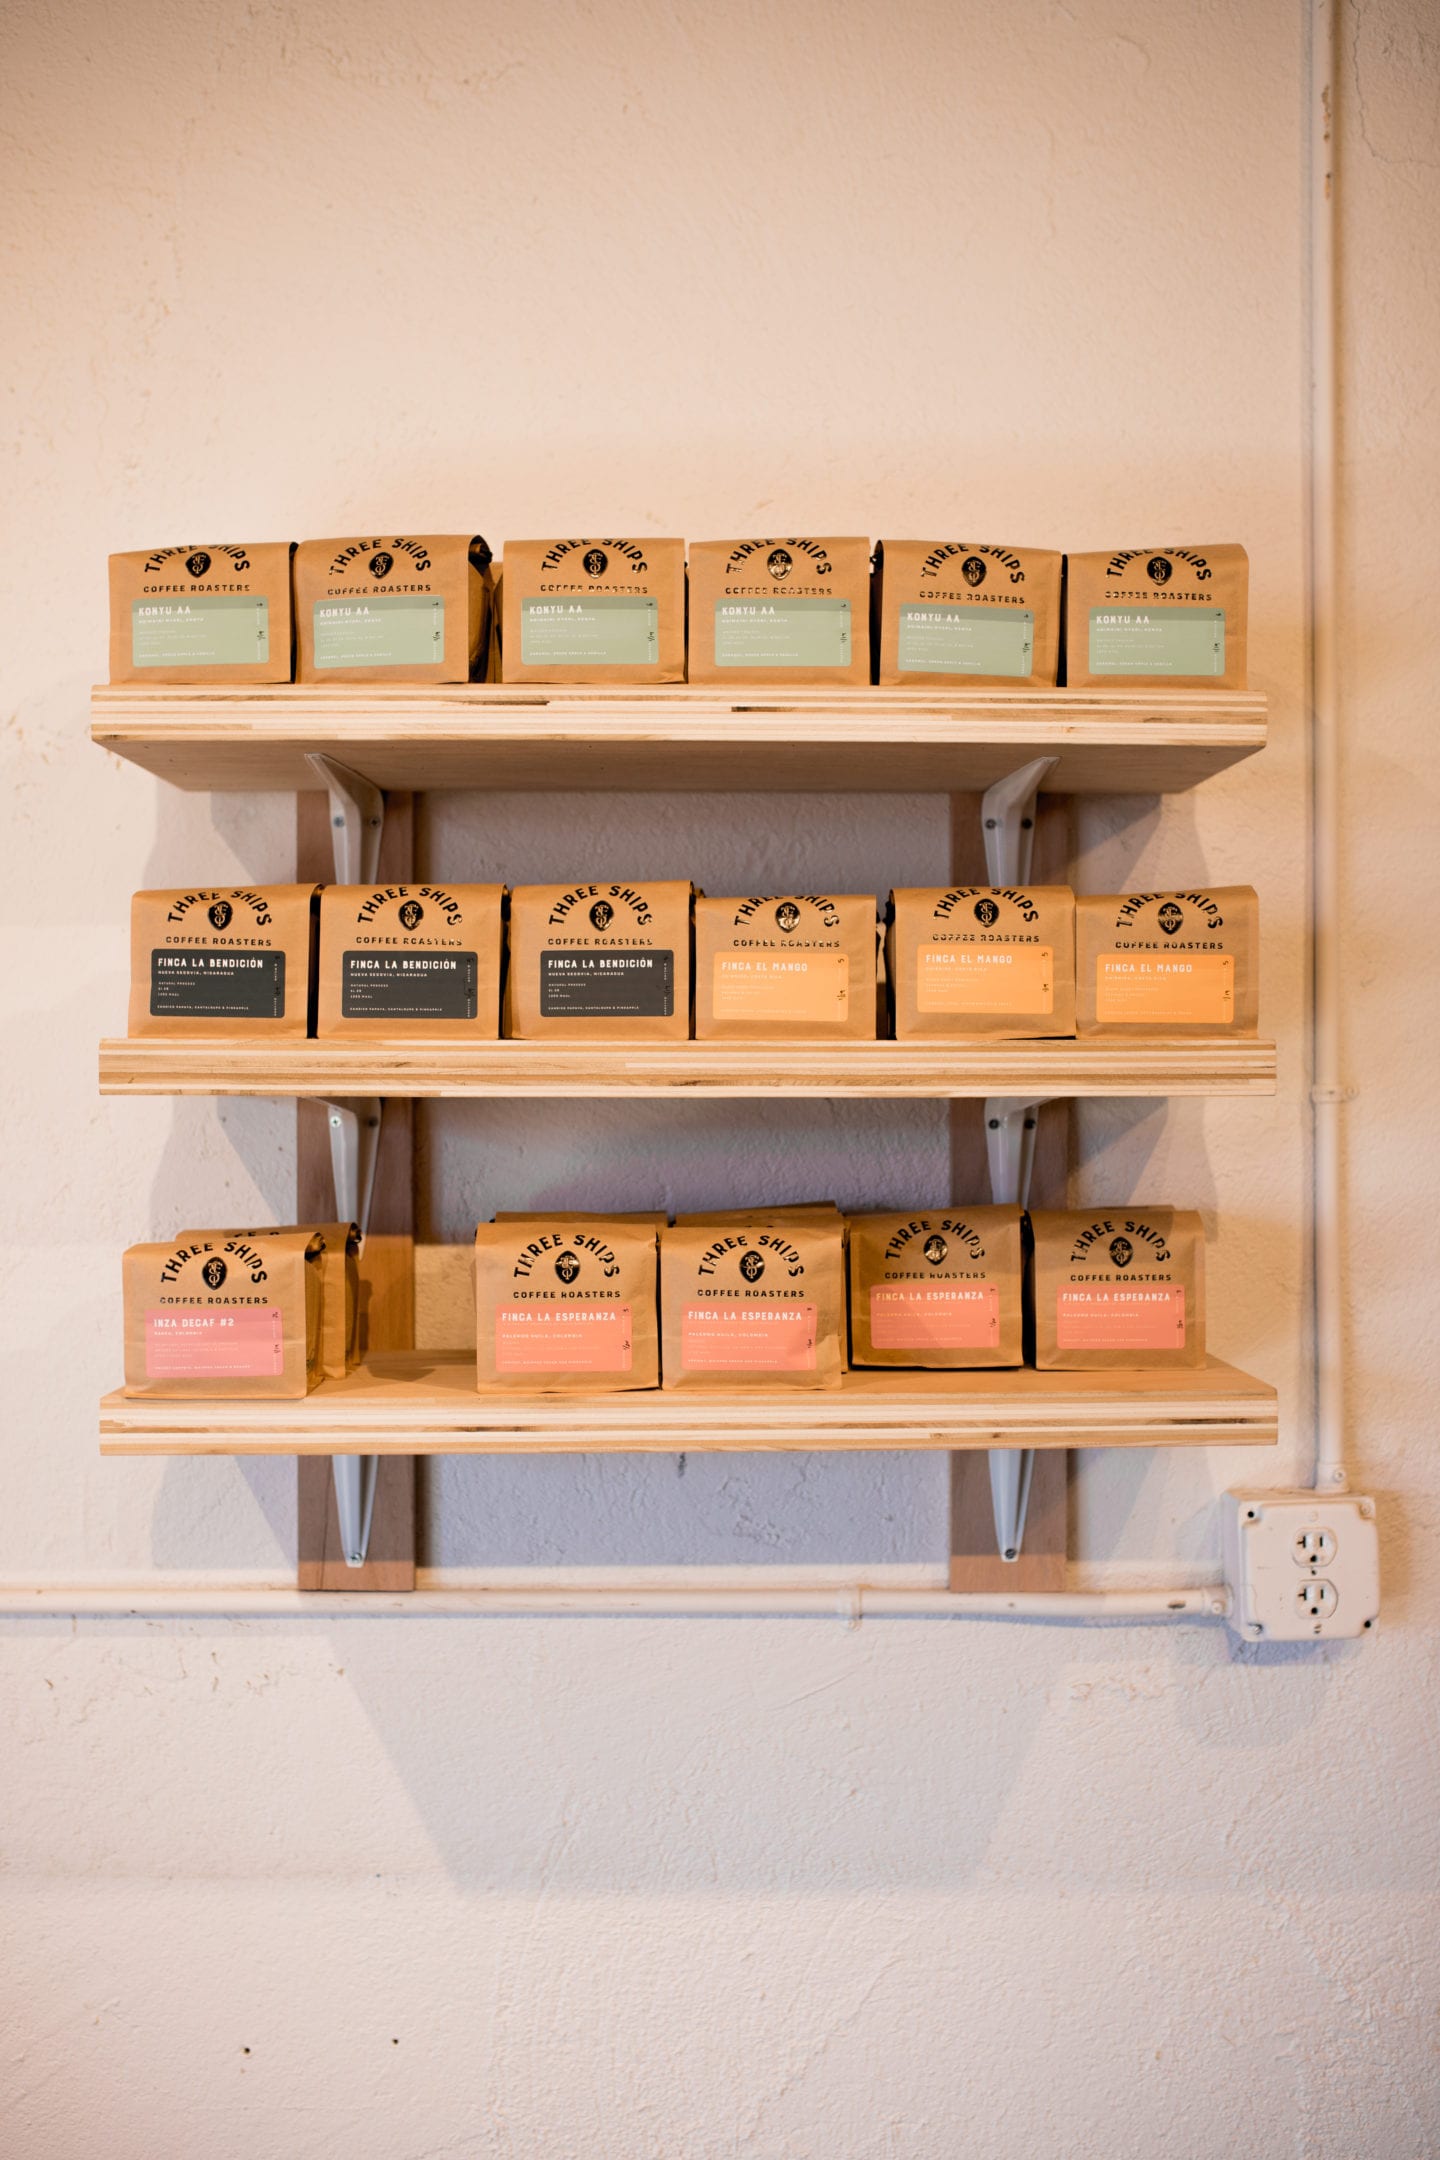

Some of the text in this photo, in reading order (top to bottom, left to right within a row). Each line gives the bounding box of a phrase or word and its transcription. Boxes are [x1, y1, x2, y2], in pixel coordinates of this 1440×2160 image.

[329, 538, 431, 575] THREE SHIPS
[541, 539, 647, 573] THREE SHIPS
[726, 538, 832, 575] THREE SHIPS
[921, 544, 1025, 584] THREE SHIPS
[1164, 548, 1212, 580] SHIPS
[191, 584, 250, 592] ROASTERS
[328, 585, 431, 595] COFFEE ROASTERS
[920, 591, 1025, 604] COFFEE ROASTERS
[139, 607, 172, 616] KONYU
[320, 607, 369, 617] KONYU AA
[530, 606, 563, 614] KONYU
[722, 607, 775, 615] KONYU AA
[907, 613, 960, 623] KONYU AA
[1096, 616, 1150, 624] KONYU AA
[168, 891, 272, 926] THREE SHIPS
[358, 887, 463, 925] THREE SHIPS
[549, 885, 653, 925] THREE SHIPS
[934, 888, 1039, 922] THREE SHIPS
[1116, 893, 1223, 929] THREE SHIPS
[213, 938, 272, 946] ROASTERS
[158, 957, 263, 968] FINCA LA BENDICIÓN
[350, 959, 456, 970] FINCA LA BENDICIÓN
[548, 958, 653, 968] FINCA LA BENDICIÓN
[926, 955, 1012, 964] FINCA EL MANGO
[722, 962, 808, 971] FINCA EL MANGO
[1105, 964, 1192, 972] FINCA EL MANGO
[885, 1220, 985, 1259] THREE SHIPS
[1071, 1221, 1171, 1262] THREE SHIPS
[514, 1234, 620, 1277] THREE SHIPS
[698, 1235, 804, 1276] THREE SHIPS
[161, 1242, 267, 1283] THREE SHIPS
[876, 1293, 904, 1301] FINCA
[927, 1292, 984, 1300] ESPERANZA
[1063, 1293, 1170, 1302] FINCA LA ESPERANZA
[502, 1312, 616, 1321] FINCA LA ESPERANZA
[688, 1311, 802, 1320] FINCA LA ESPERANZA
[154, 1318, 234, 1327] INZA DECAF #2
